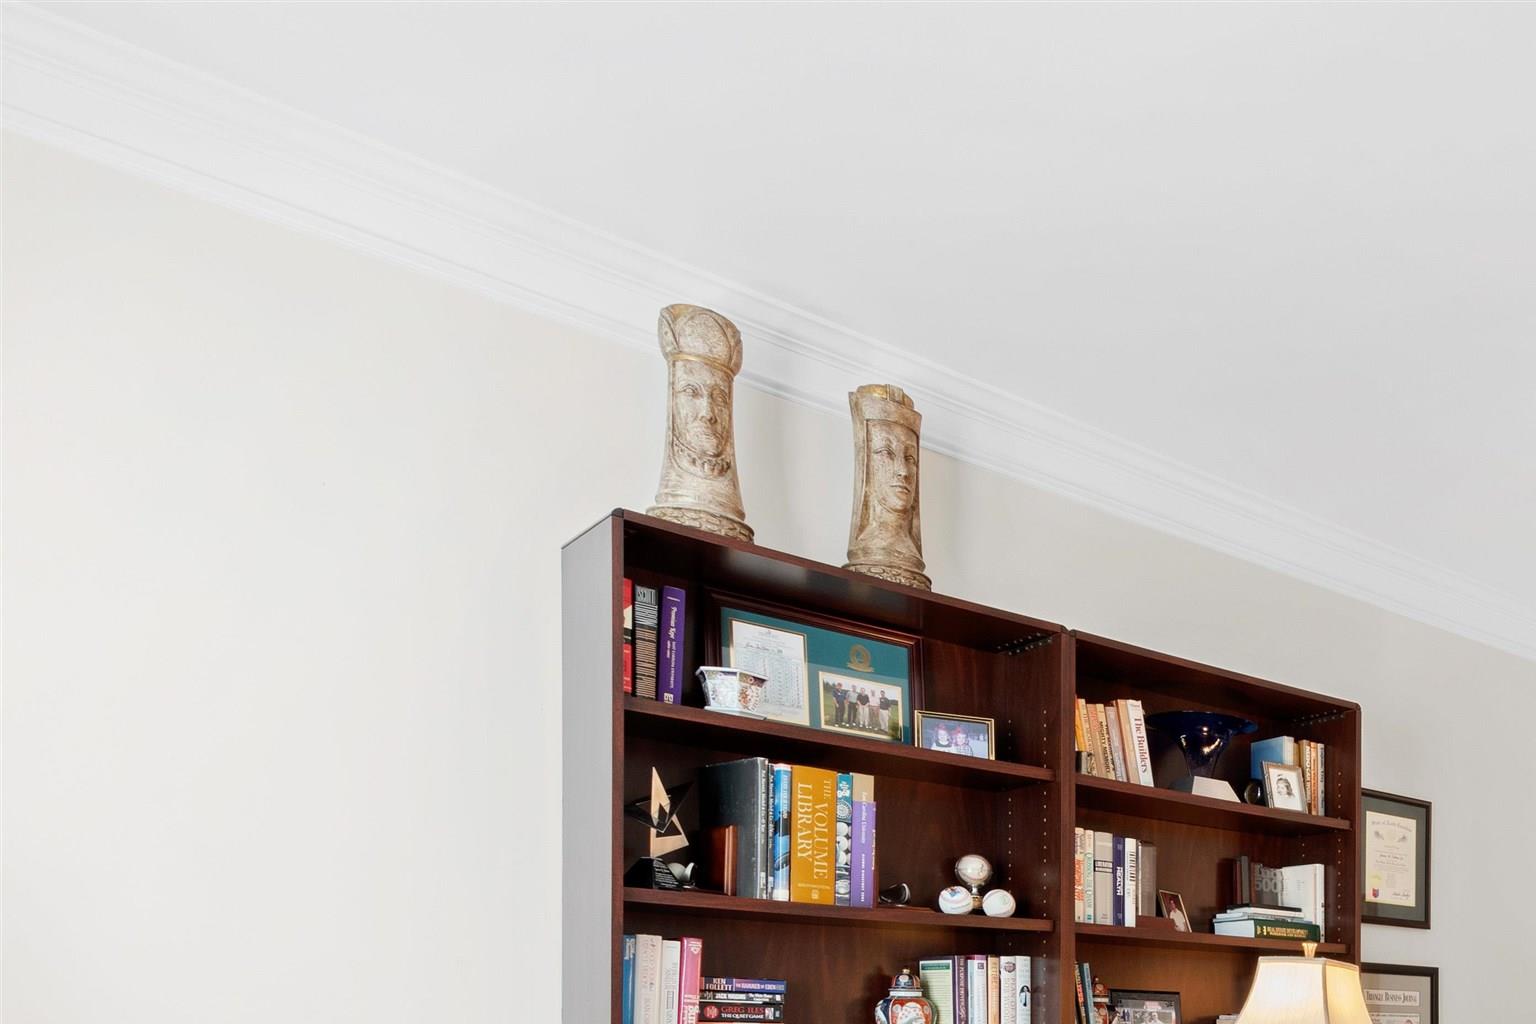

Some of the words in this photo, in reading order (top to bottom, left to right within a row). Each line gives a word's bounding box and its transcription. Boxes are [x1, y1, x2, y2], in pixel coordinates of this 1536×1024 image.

[1134, 718, 1143, 734] The
[1136, 735, 1149, 774] Builders
[823, 779, 832, 800] THE
[797, 782, 813, 862] LIBRARY
[812, 802, 829, 880] VOLUME
[706, 983, 733, 991] FOLLETT
